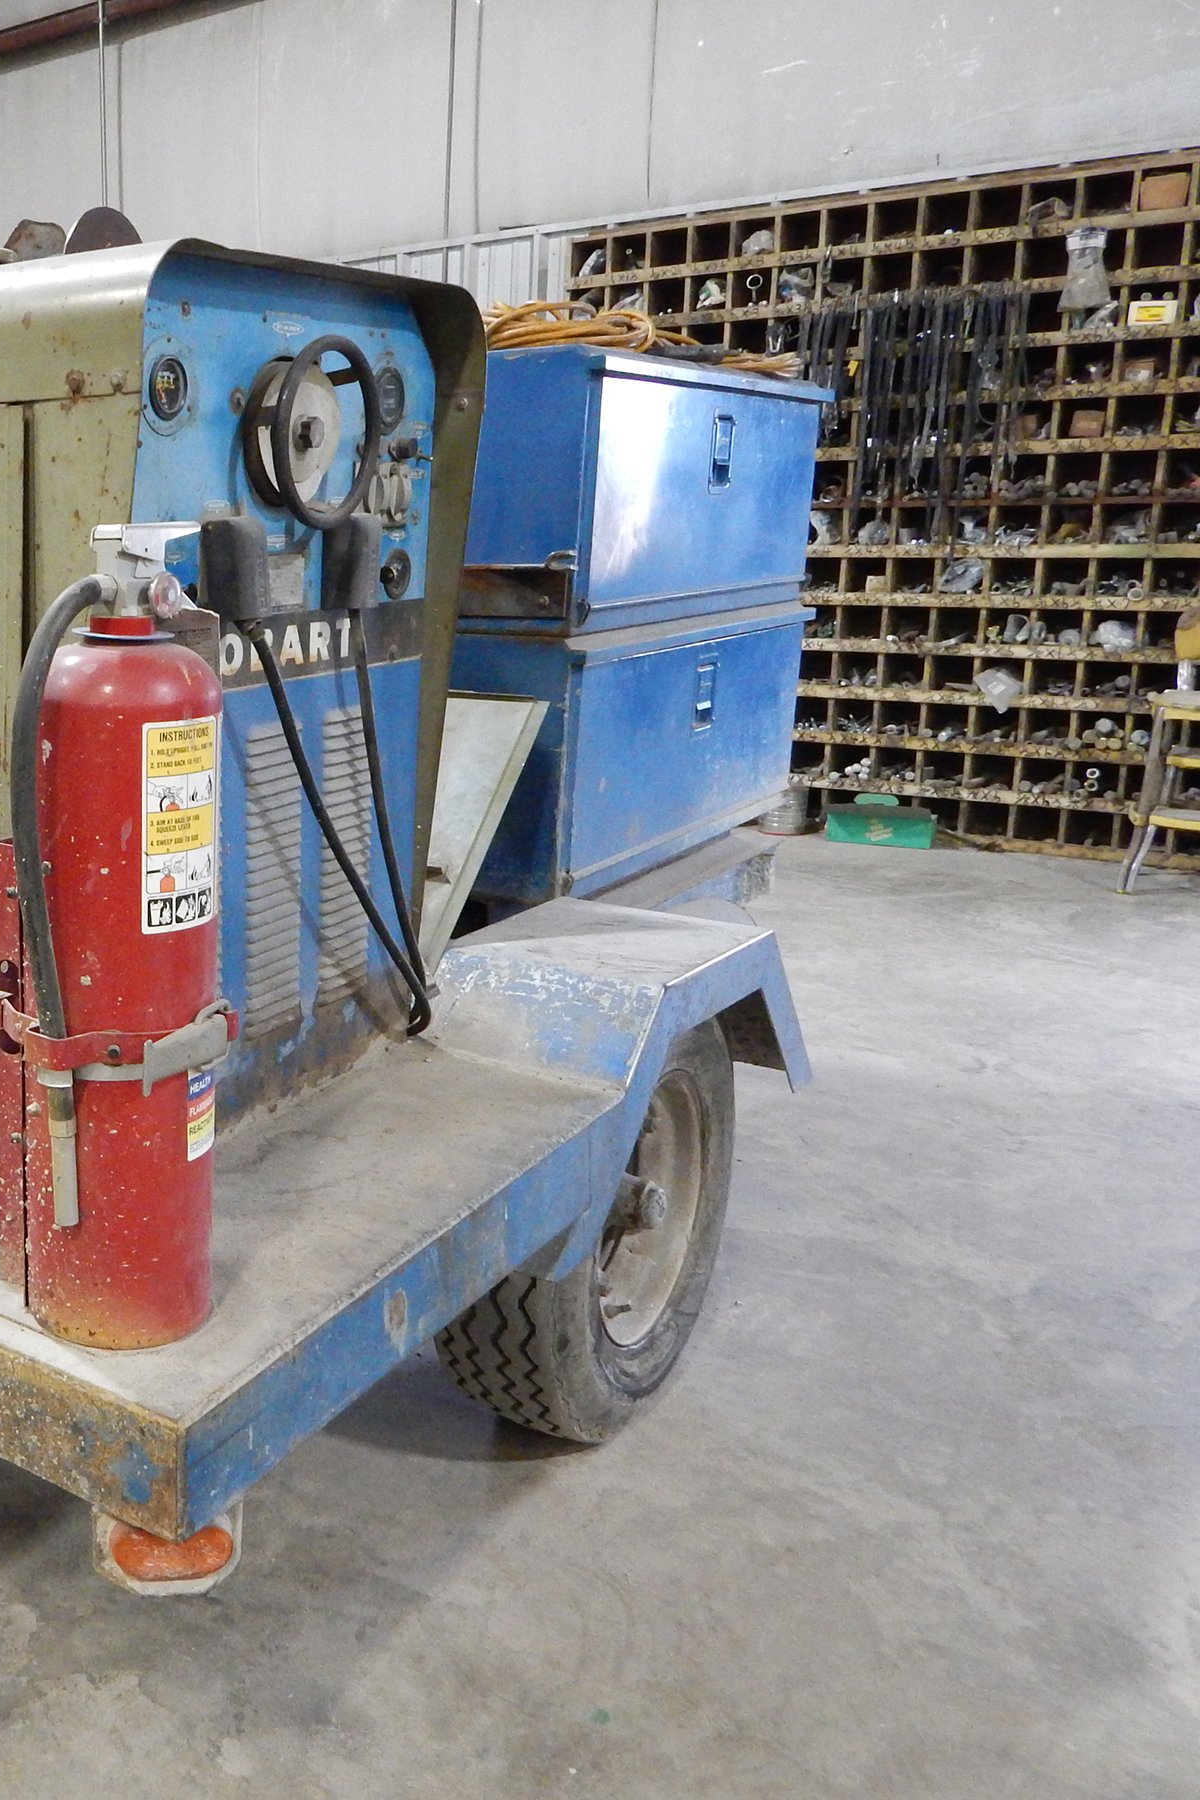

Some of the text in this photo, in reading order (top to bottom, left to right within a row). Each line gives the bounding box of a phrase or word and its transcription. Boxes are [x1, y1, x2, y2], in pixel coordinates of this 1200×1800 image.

[220, 617, 351, 676] OART
[160, 726, 209, 742] INSTRUCTIONS
[157, 761, 173, 769] STAND
[174, 759, 186, 767] BACK
